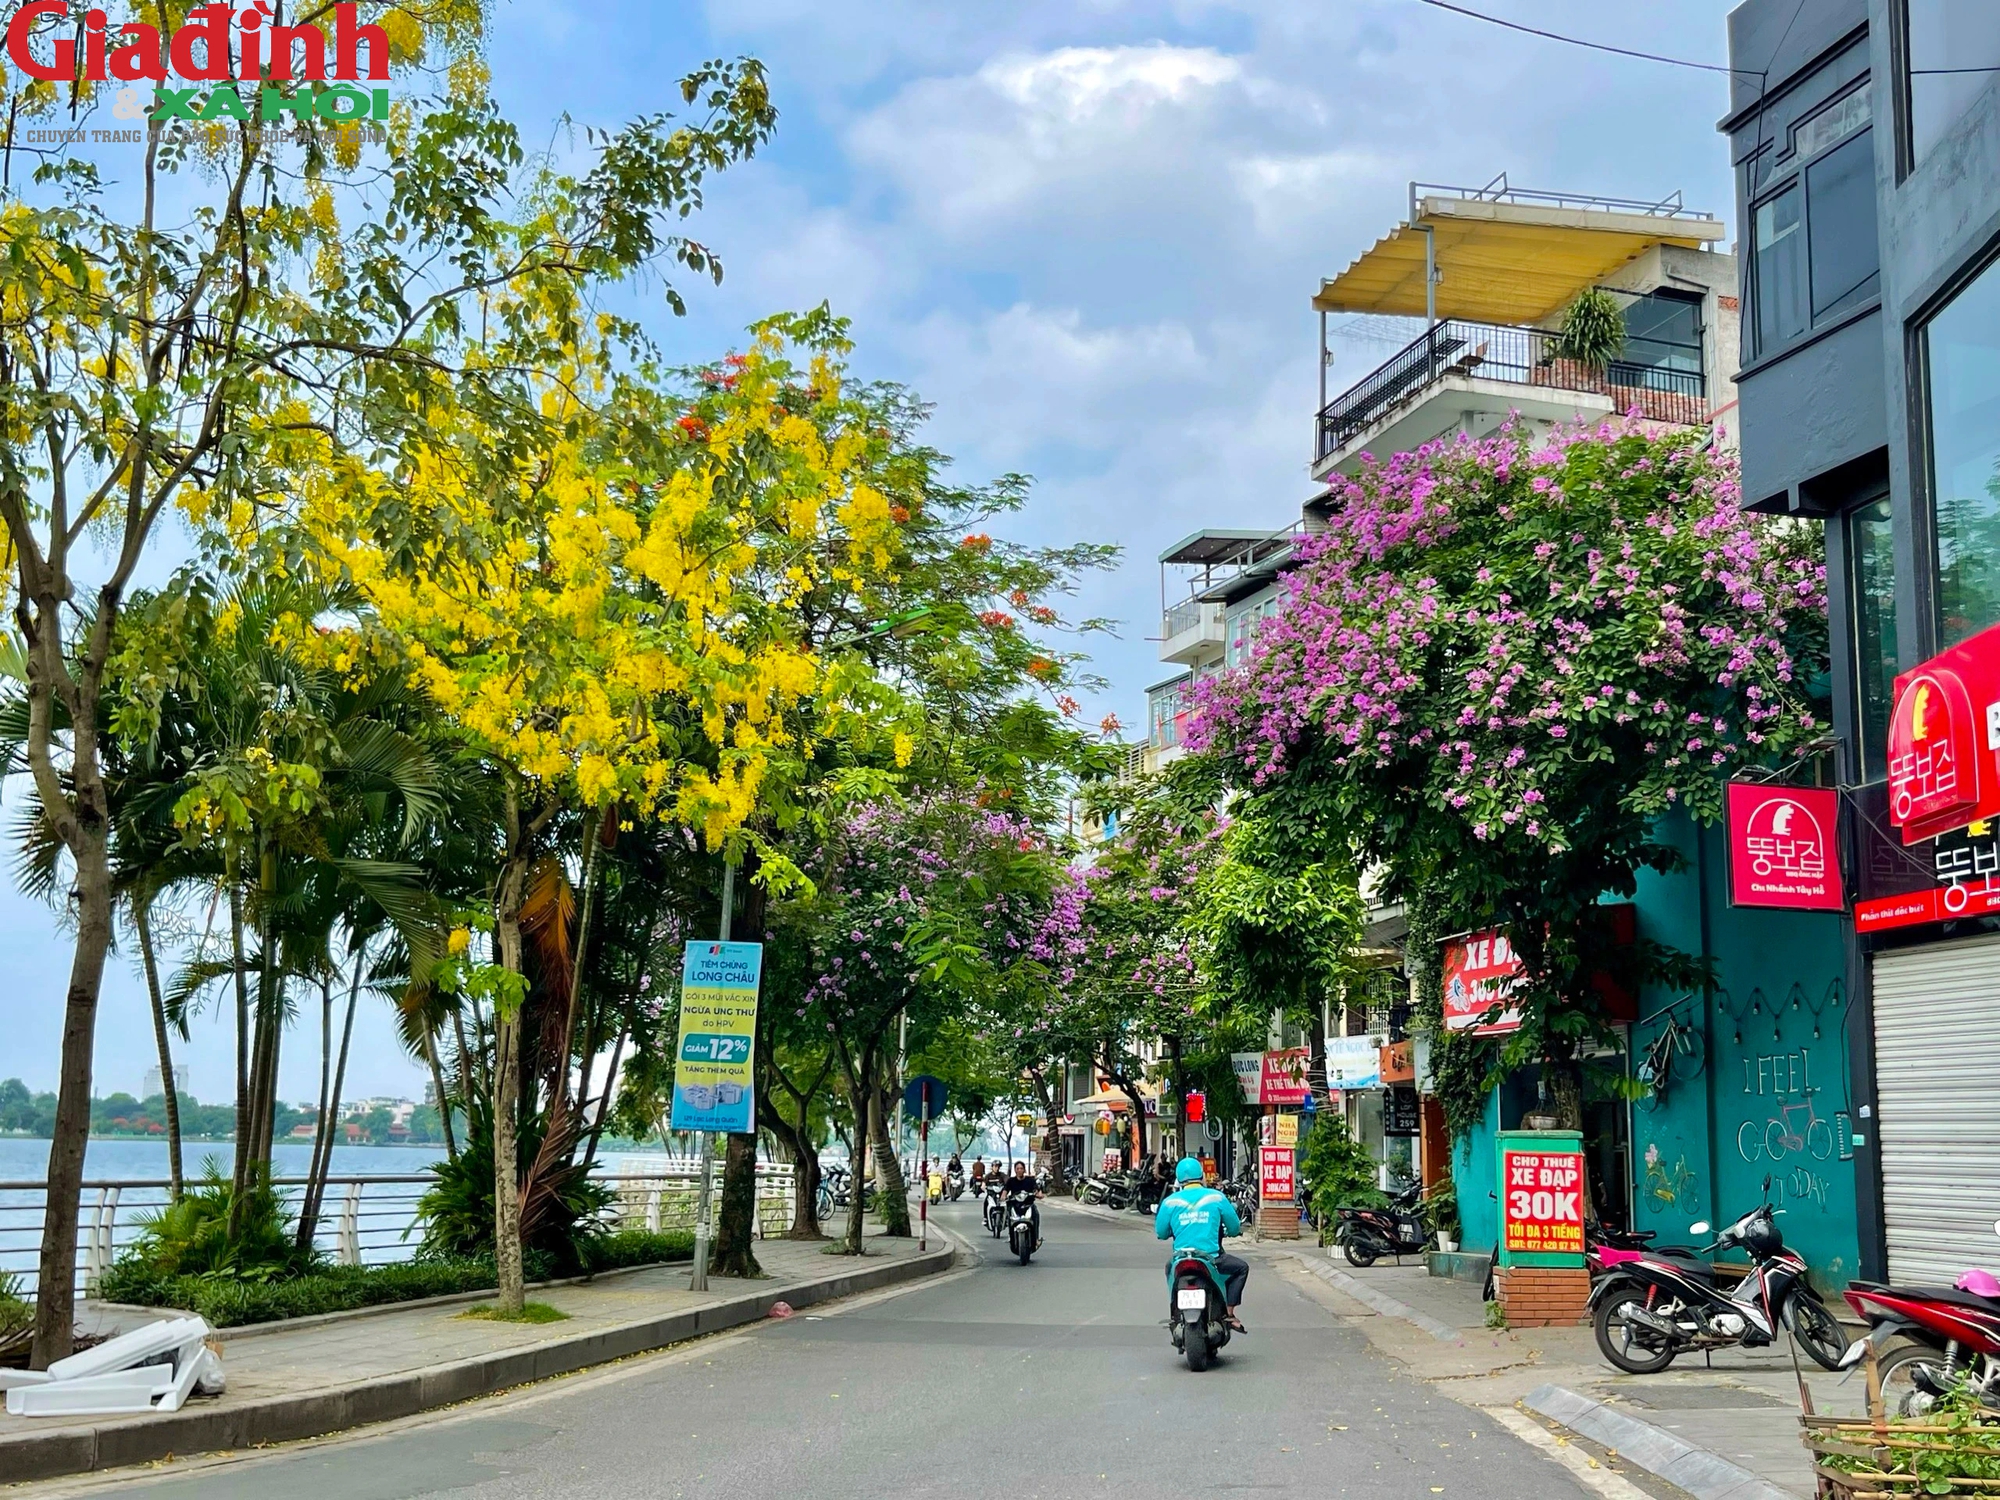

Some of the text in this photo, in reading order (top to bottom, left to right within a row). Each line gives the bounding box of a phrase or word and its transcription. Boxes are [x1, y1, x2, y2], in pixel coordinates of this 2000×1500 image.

[1746, 836, 1825, 876] 뚱보집
[1463, 936, 1523, 972] XE ĐẠ
[692, 971, 755, 983] LONG CHÂU
[703, 1019, 714, 1027] do
[1743, 1046, 1822, 1096] I FEEL
[1399, 1119, 1415, 1127] 259
[1512, 1156, 1576, 1169] CHO THUÊ
[1264, 1165, 1292, 1183] XE ĐẠP
[1511, 1167, 1578, 1191] XE ĐẠP
[1775, 1164, 1831, 1214] TODAY
[1509, 1190, 1579, 1221] 30K
[1508, 1220, 1581, 1240] TỐI ĐA 3 TIẾNG
